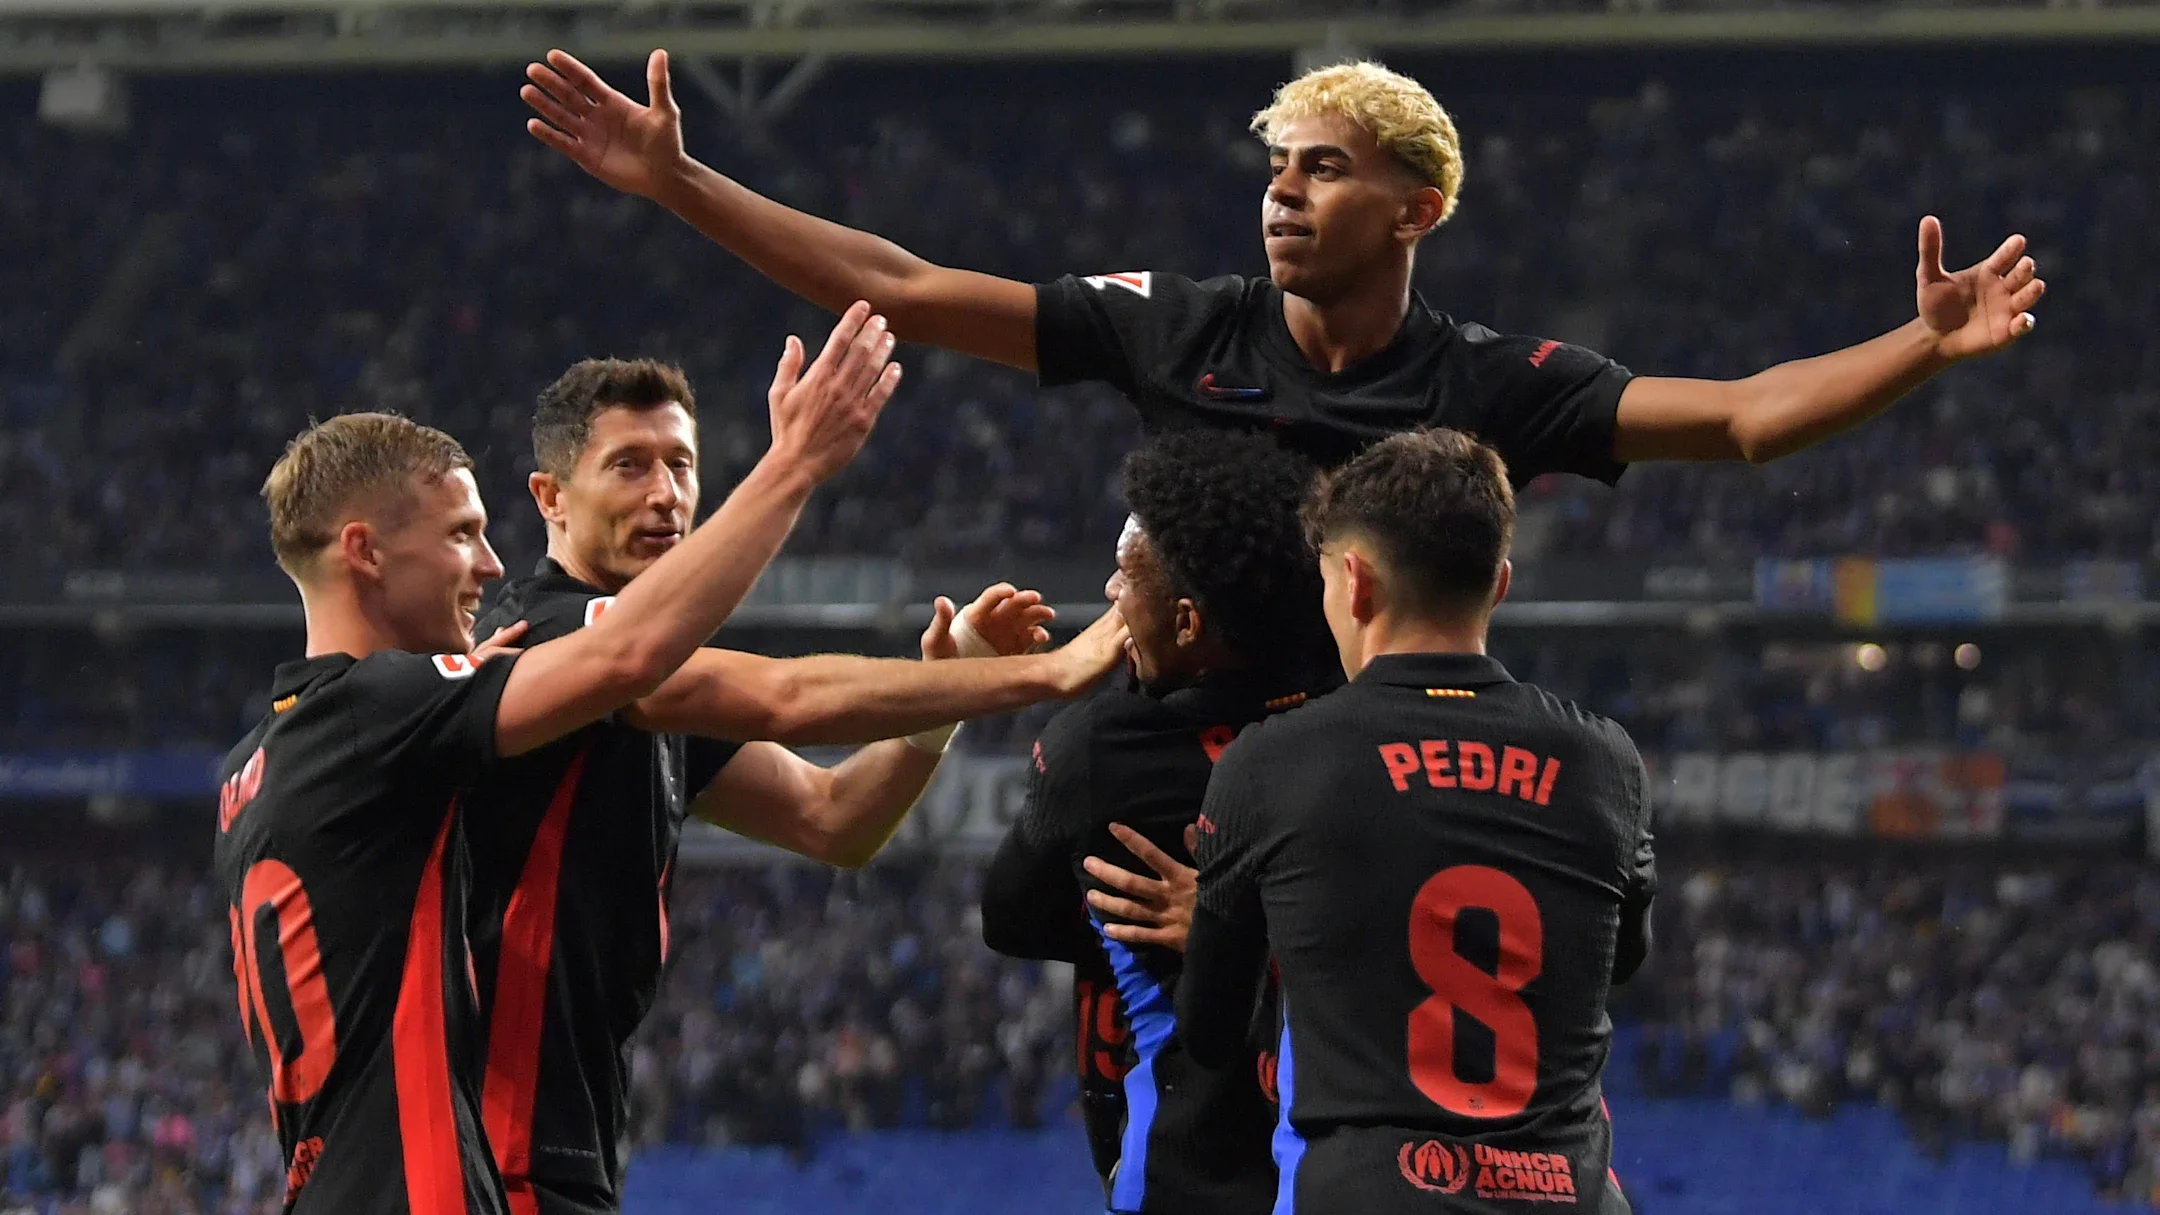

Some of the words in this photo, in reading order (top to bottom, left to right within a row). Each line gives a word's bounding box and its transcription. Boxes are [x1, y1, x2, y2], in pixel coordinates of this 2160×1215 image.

[1379, 739, 1561, 806] PEDRI
[1408, 864, 1543, 1118] 8
[1474, 1143, 1571, 1174] UNHCR
[1475, 1166, 1575, 1194] ACNUR
